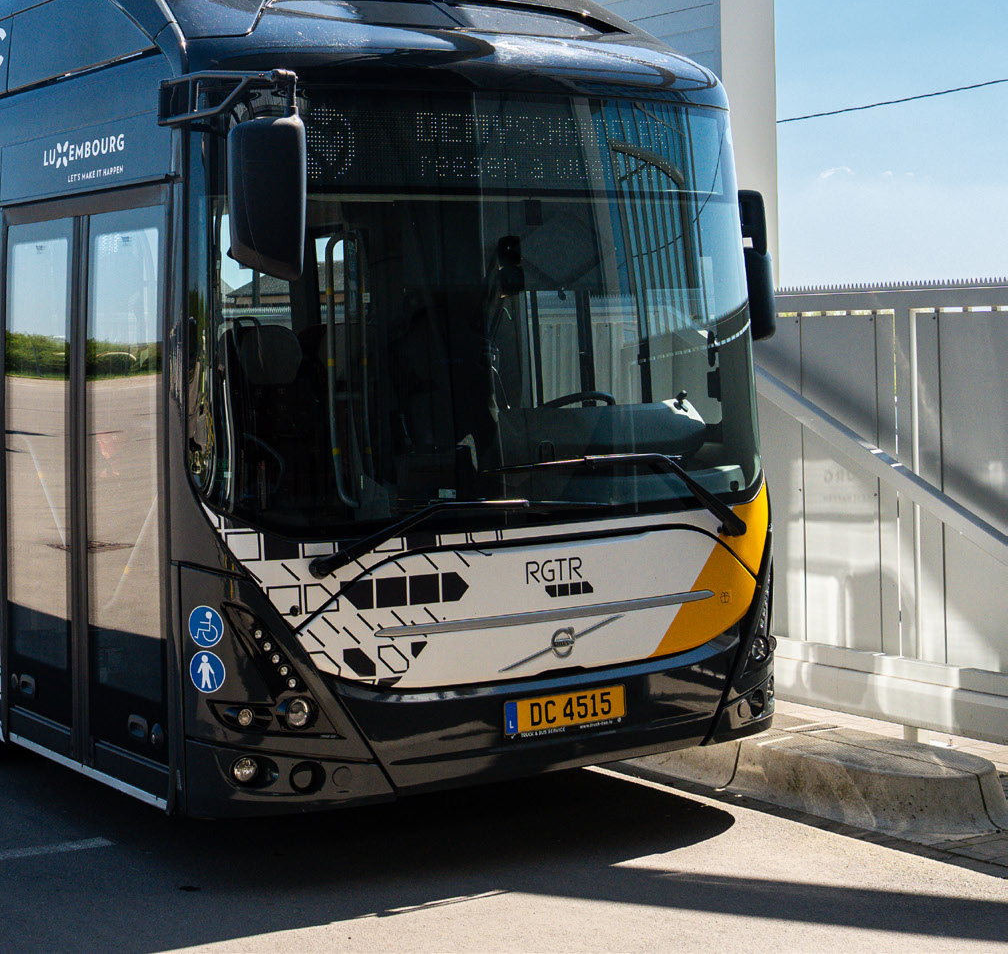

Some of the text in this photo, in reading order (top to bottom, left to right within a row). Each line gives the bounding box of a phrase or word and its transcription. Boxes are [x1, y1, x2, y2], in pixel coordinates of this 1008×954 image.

[43, 133, 125, 169] LUXEMBOURG
[67, 165, 124, 183] LET'S MAKE IT HAPPEN
[530, 158, 544, 179] a
[525, 556, 583, 585] RGTR
[530, 692, 612, 727] DC 4515
[509, 720, 514, 729] L
